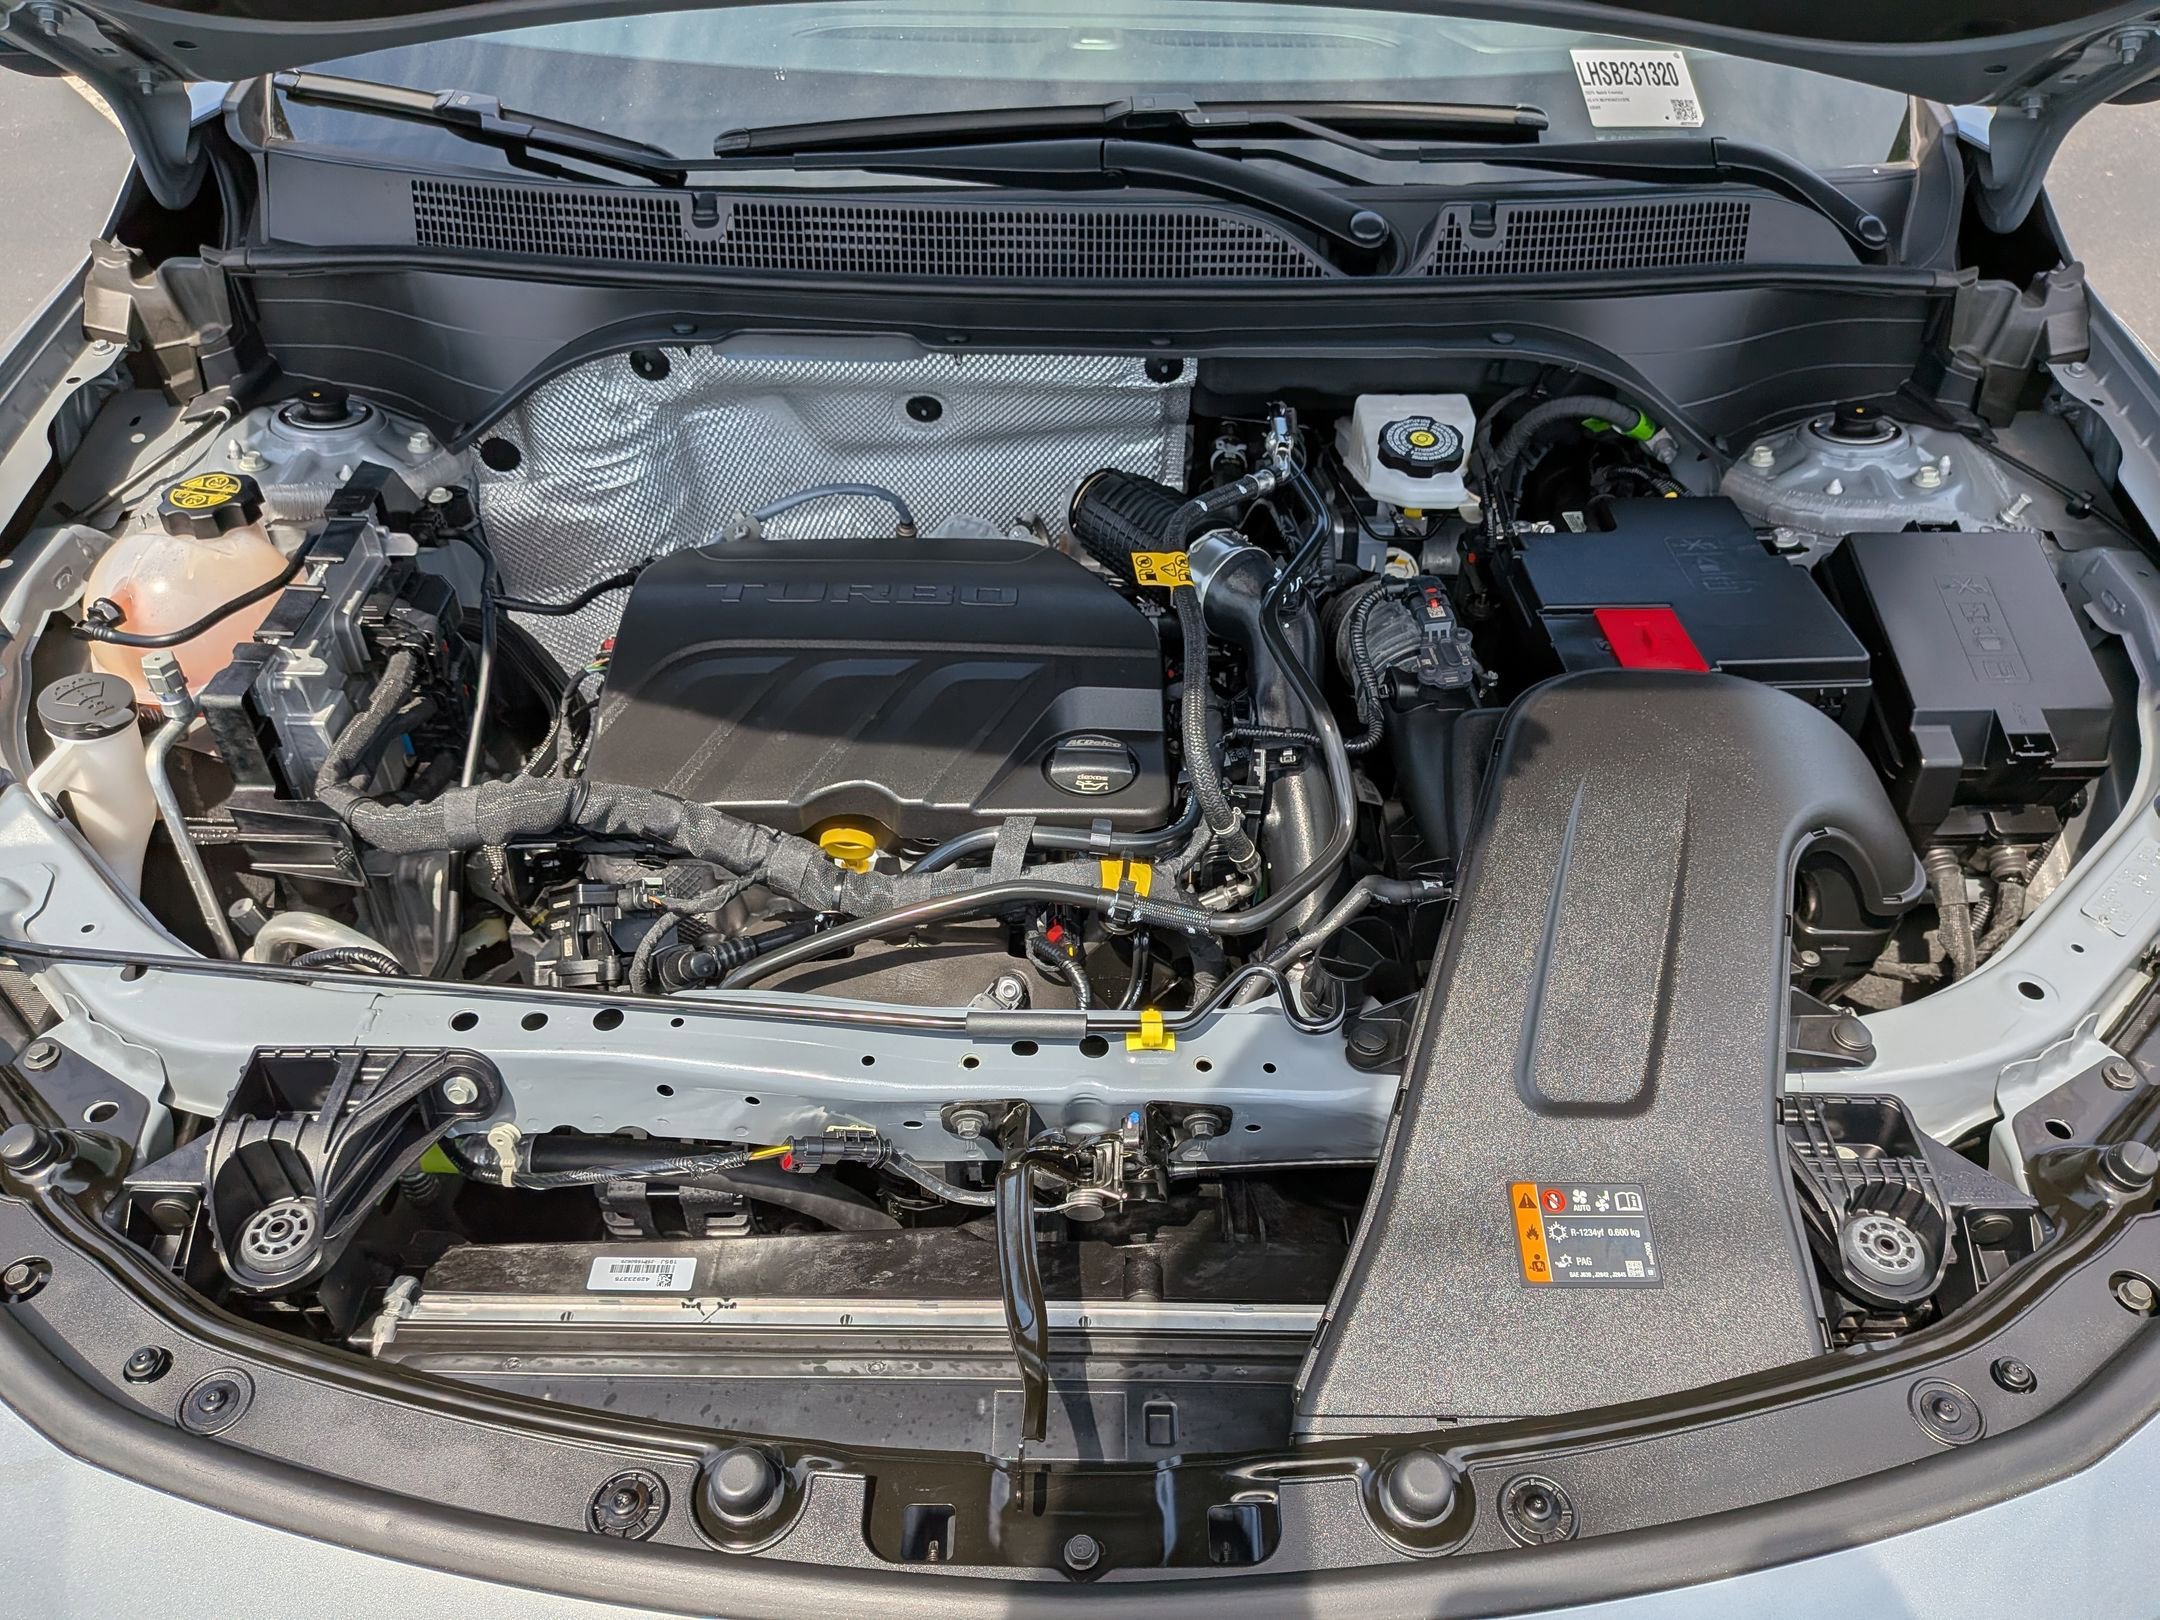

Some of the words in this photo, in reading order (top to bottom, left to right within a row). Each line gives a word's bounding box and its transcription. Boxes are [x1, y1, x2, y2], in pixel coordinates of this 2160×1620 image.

[1577, 61, 1680, 87] LHSB231320
[705, 583, 1019, 606] TURBO
[1065, 739, 1122, 748] ACDelco
[1077, 773, 1109, 781] dexos
[1573, 1204, 1591, 1212] AUTO
[1570, 1228, 1604, 1238] R-1234yf
[1608, 1228, 1629, 1237] 0.600
[1630, 1228, 1641, 1238] kg
[1576, 1257, 1593, 1266] PAG
